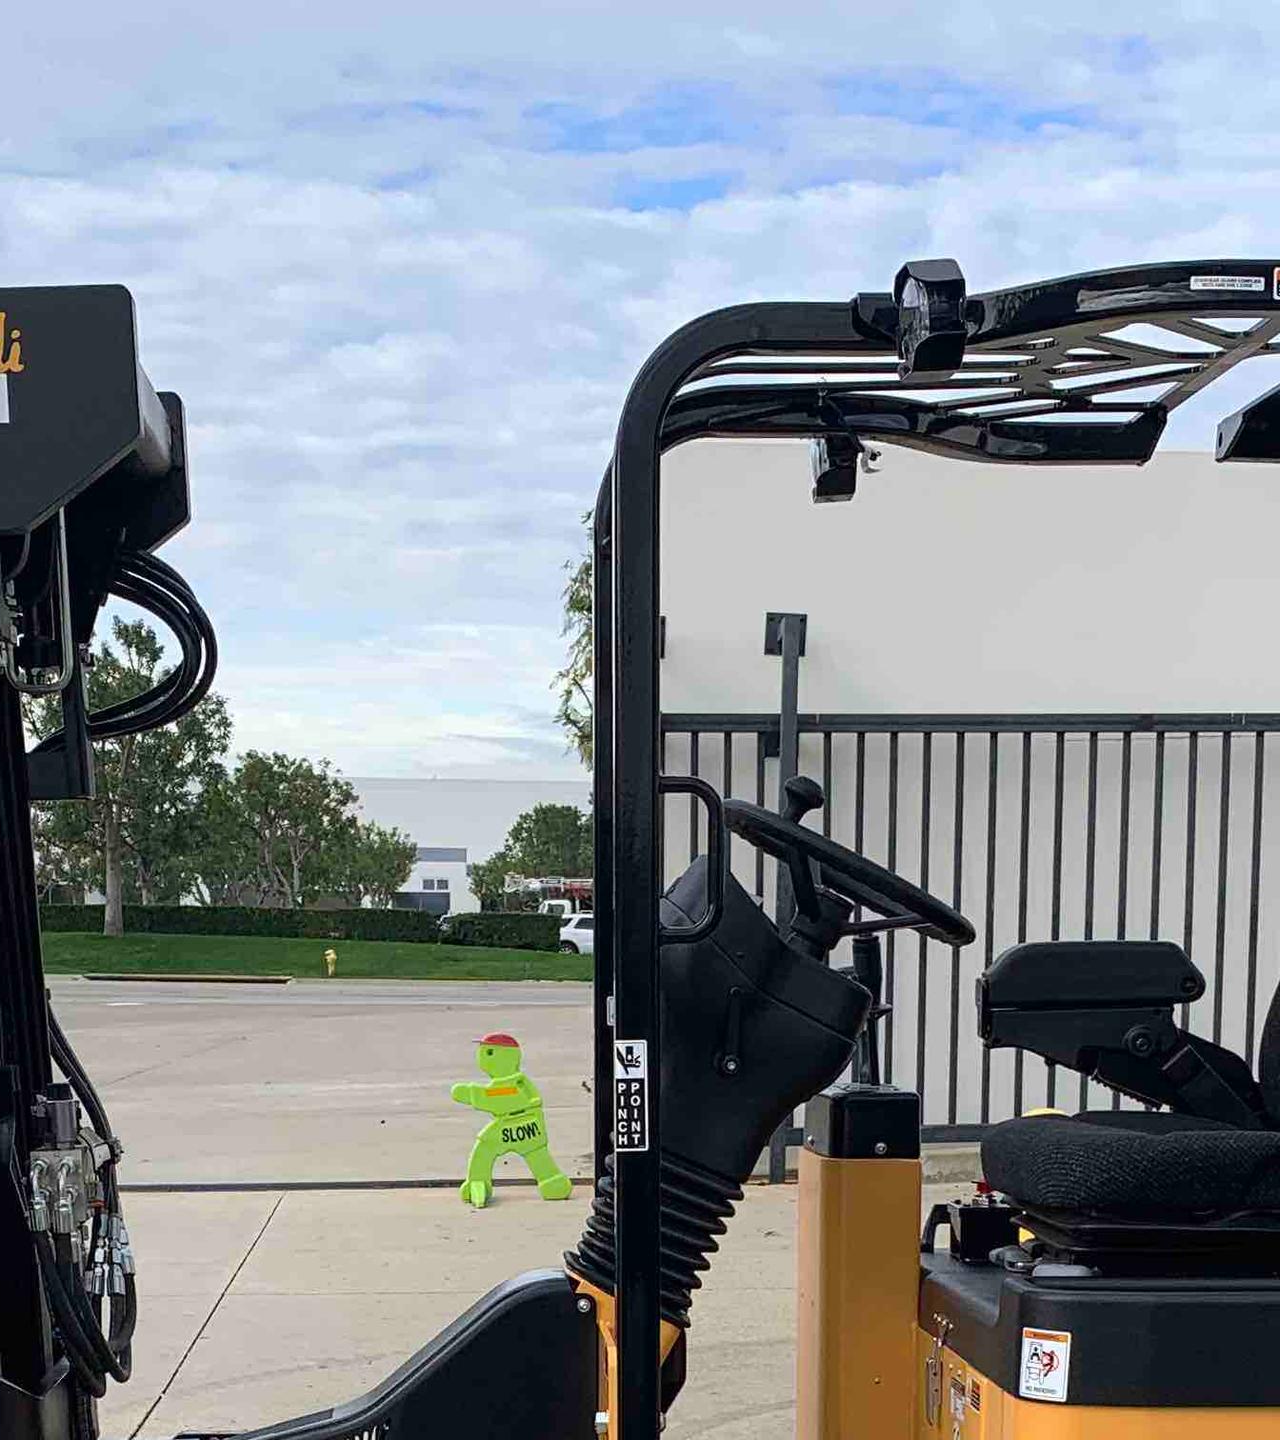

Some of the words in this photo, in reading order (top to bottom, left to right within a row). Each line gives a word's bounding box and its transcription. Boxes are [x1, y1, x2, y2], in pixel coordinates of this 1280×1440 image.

[501, 1121, 541, 1143] SLOW!
[618, 1083, 628, 1146] PINCH
[631, 1083, 641, 1145] POINT
